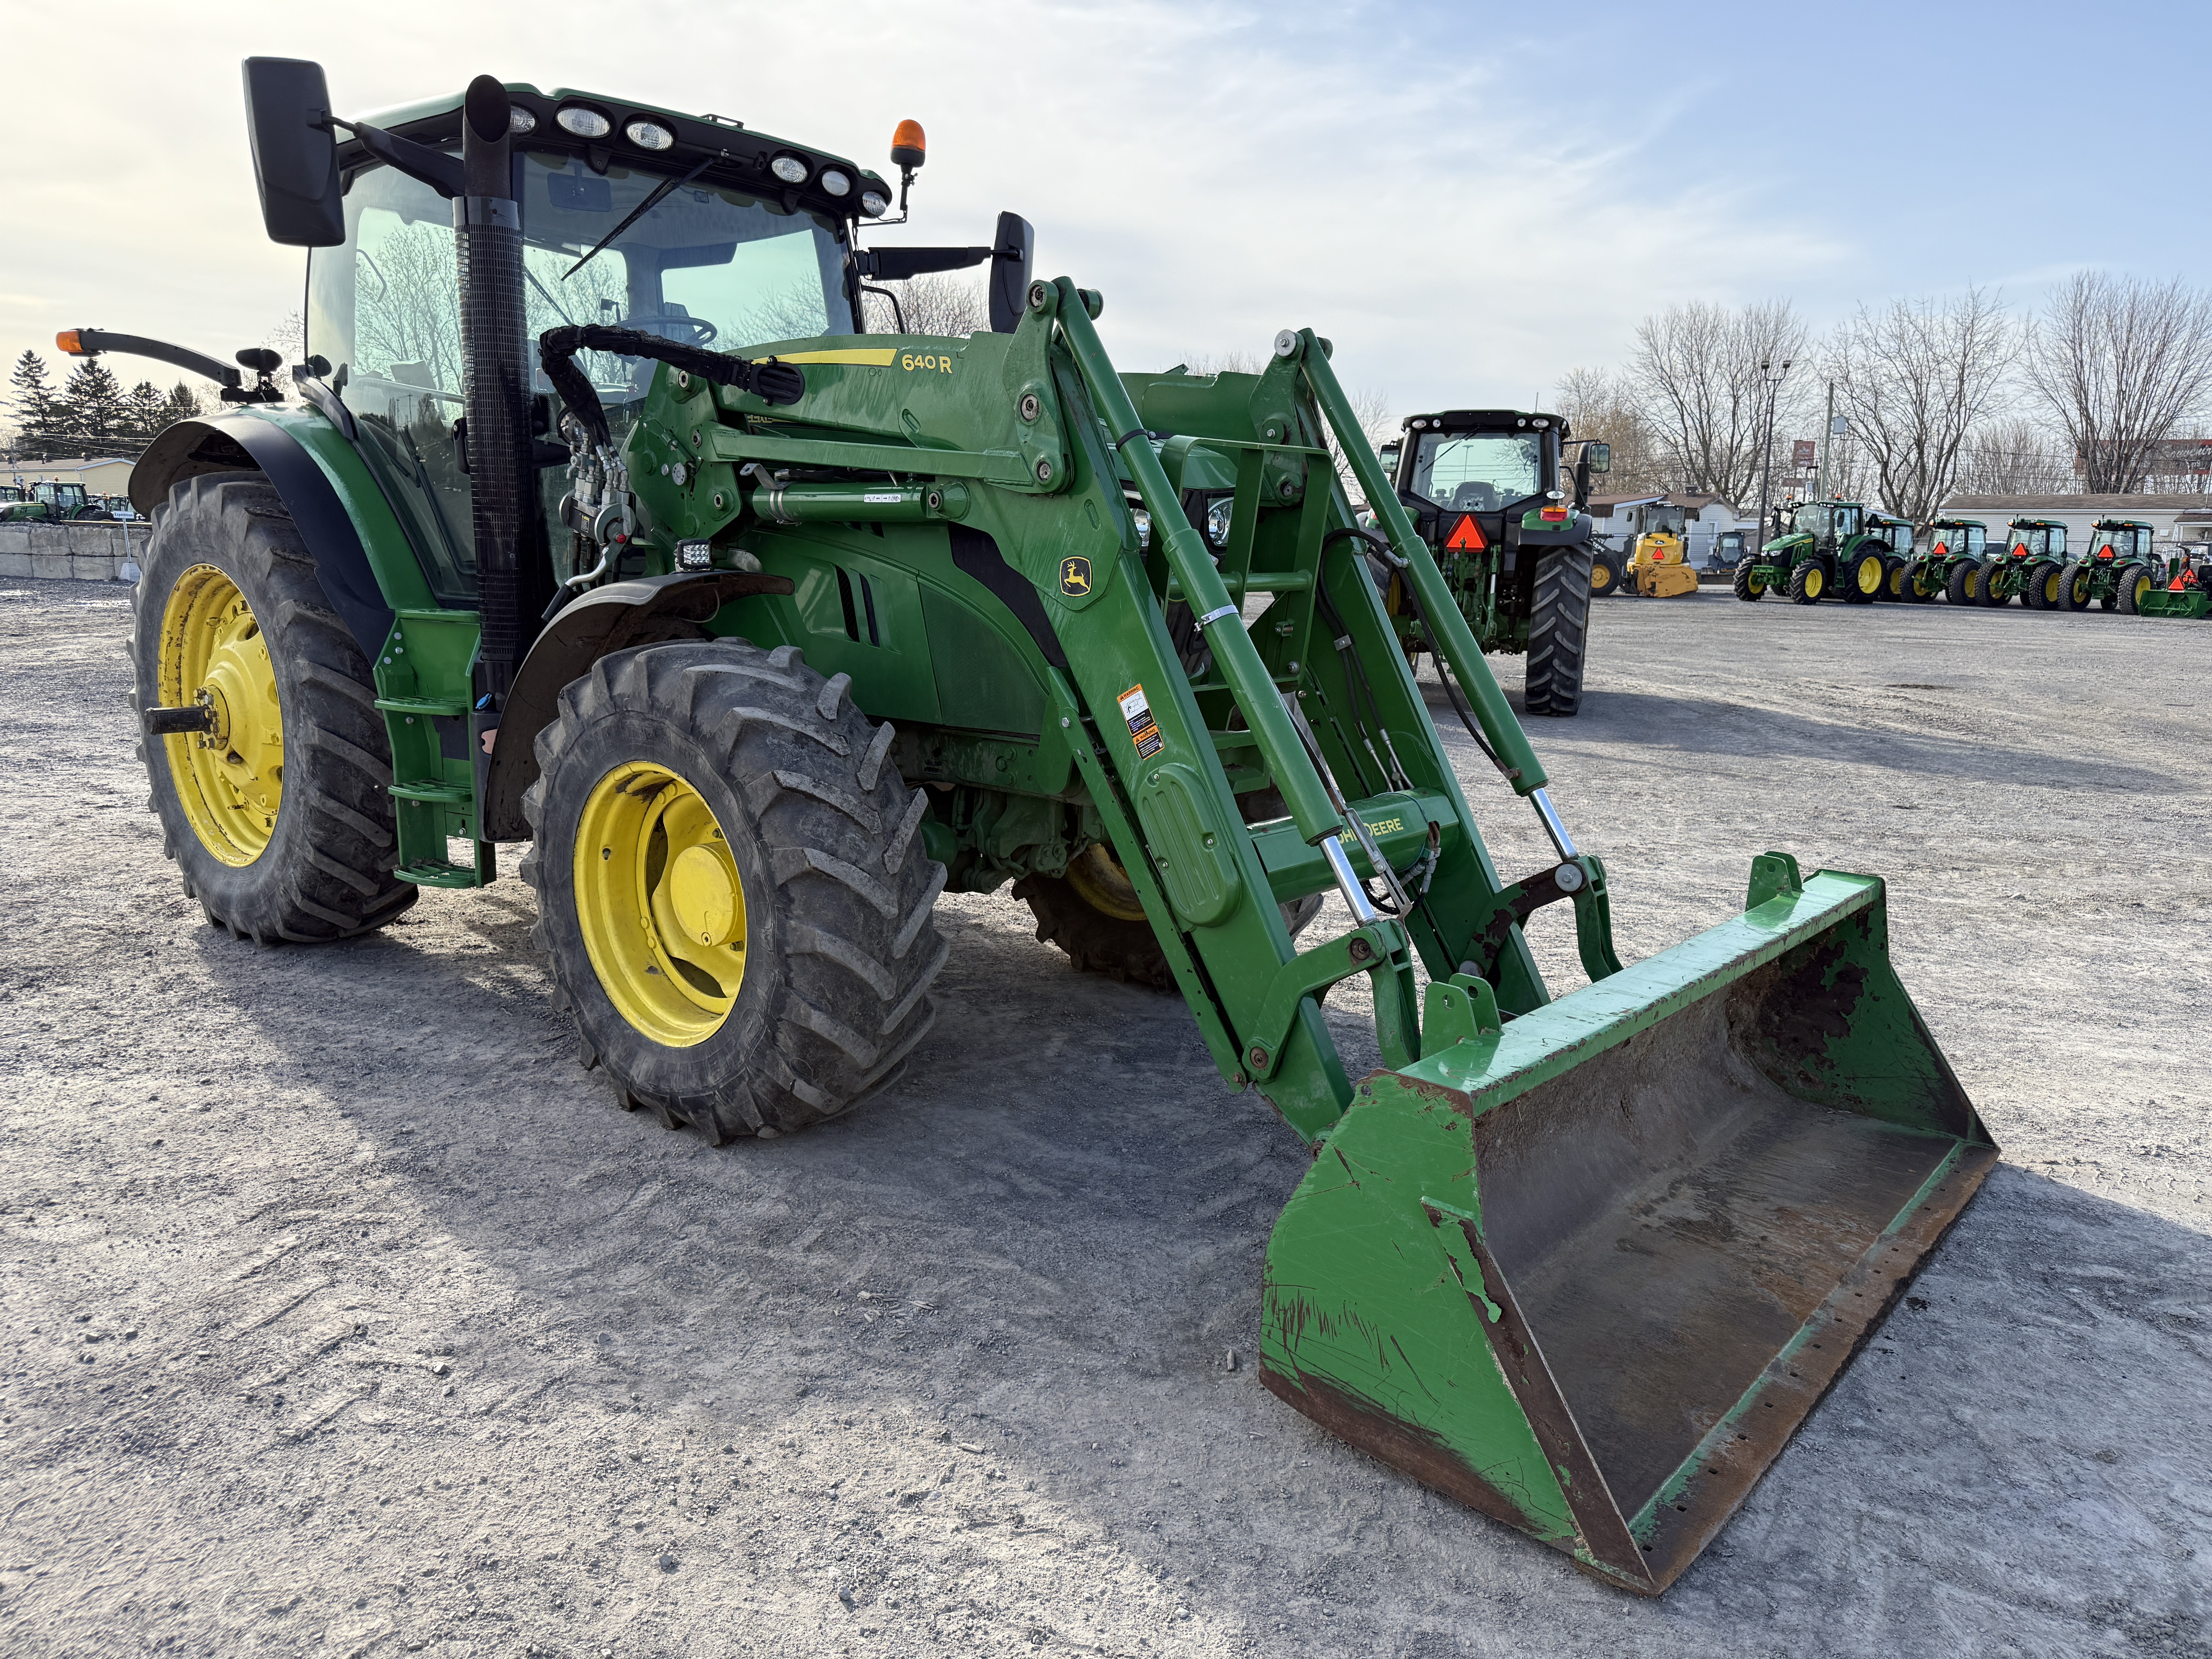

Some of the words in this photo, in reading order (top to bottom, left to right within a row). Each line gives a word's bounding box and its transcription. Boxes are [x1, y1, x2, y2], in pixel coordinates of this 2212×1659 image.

[902, 354, 936, 371] 640
[939, 356, 953, 374] R
[1123, 687, 1139, 698] WARNING
[1140, 728, 1156, 739] WARNING
[1338, 828, 1358, 845] OH
